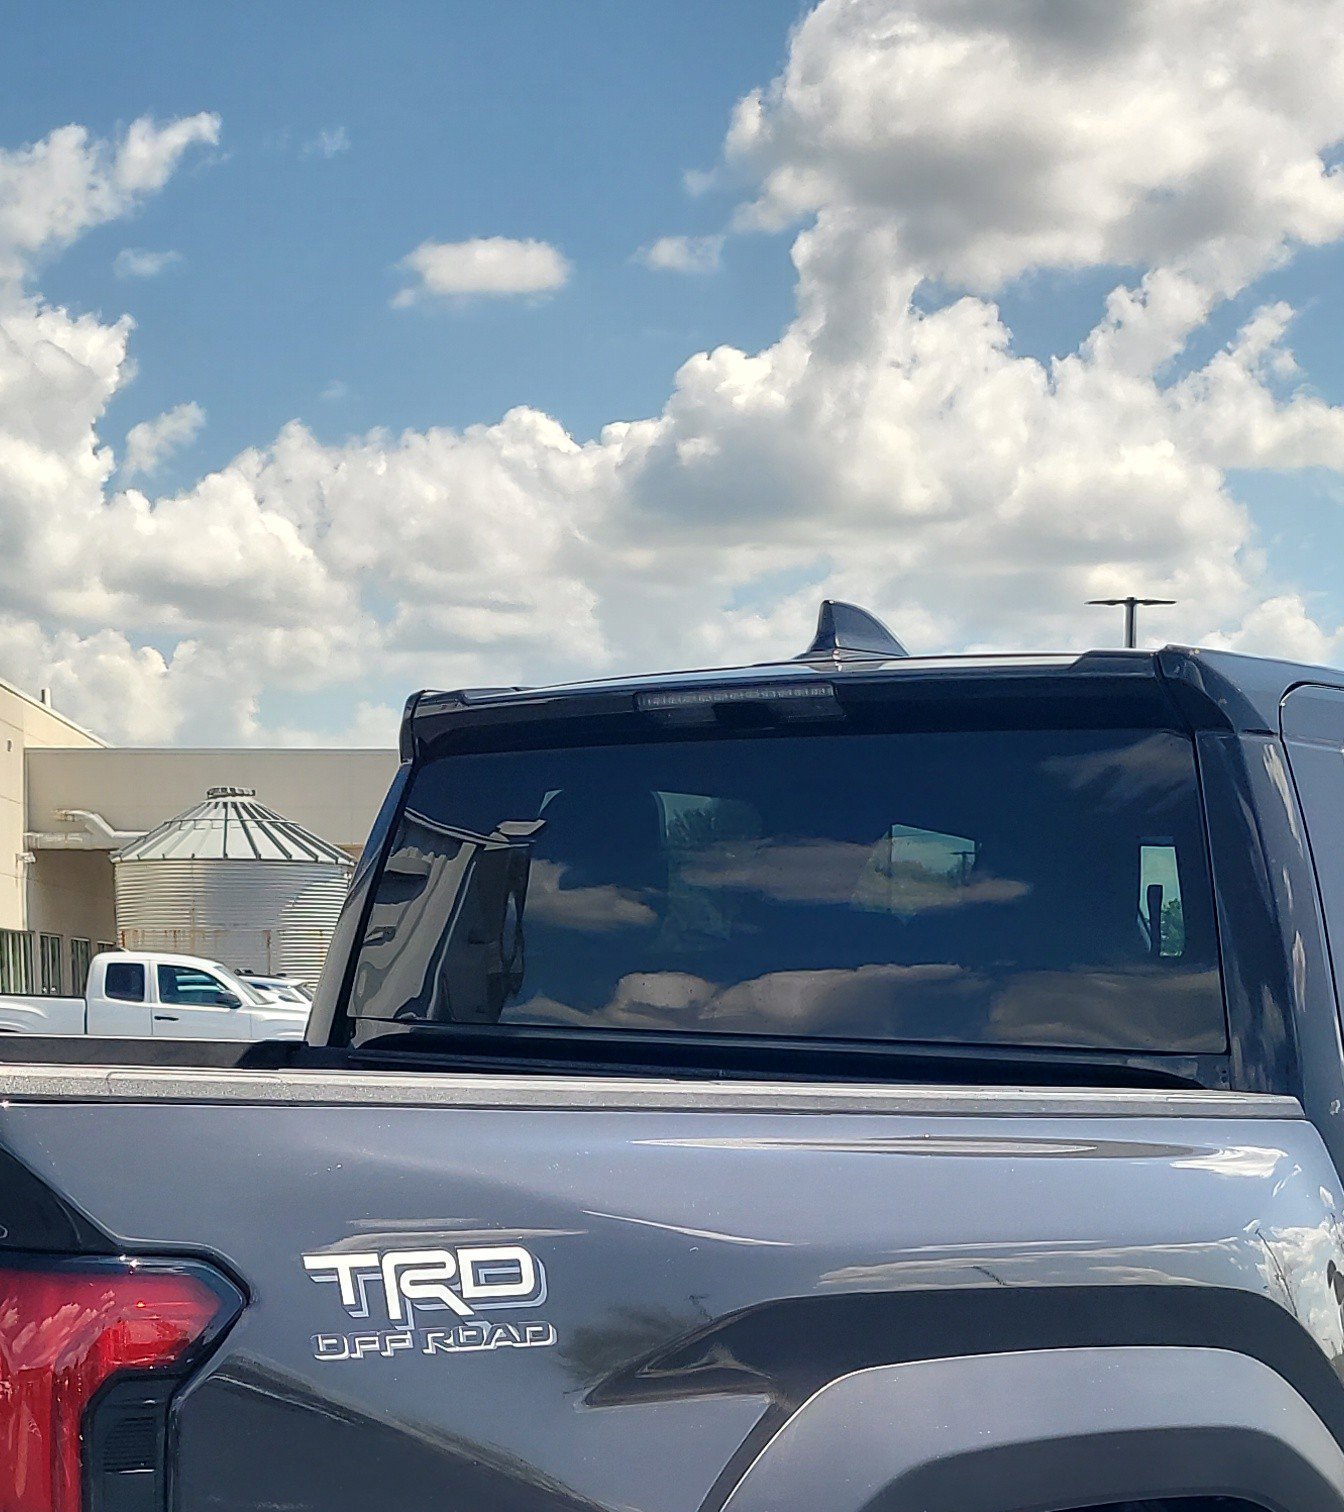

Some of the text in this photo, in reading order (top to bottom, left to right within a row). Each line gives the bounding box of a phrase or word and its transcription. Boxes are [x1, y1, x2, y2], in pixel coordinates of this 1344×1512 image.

[302, 1246, 536, 1320] TRD
[311, 1319, 558, 1361] OFF ROAD
